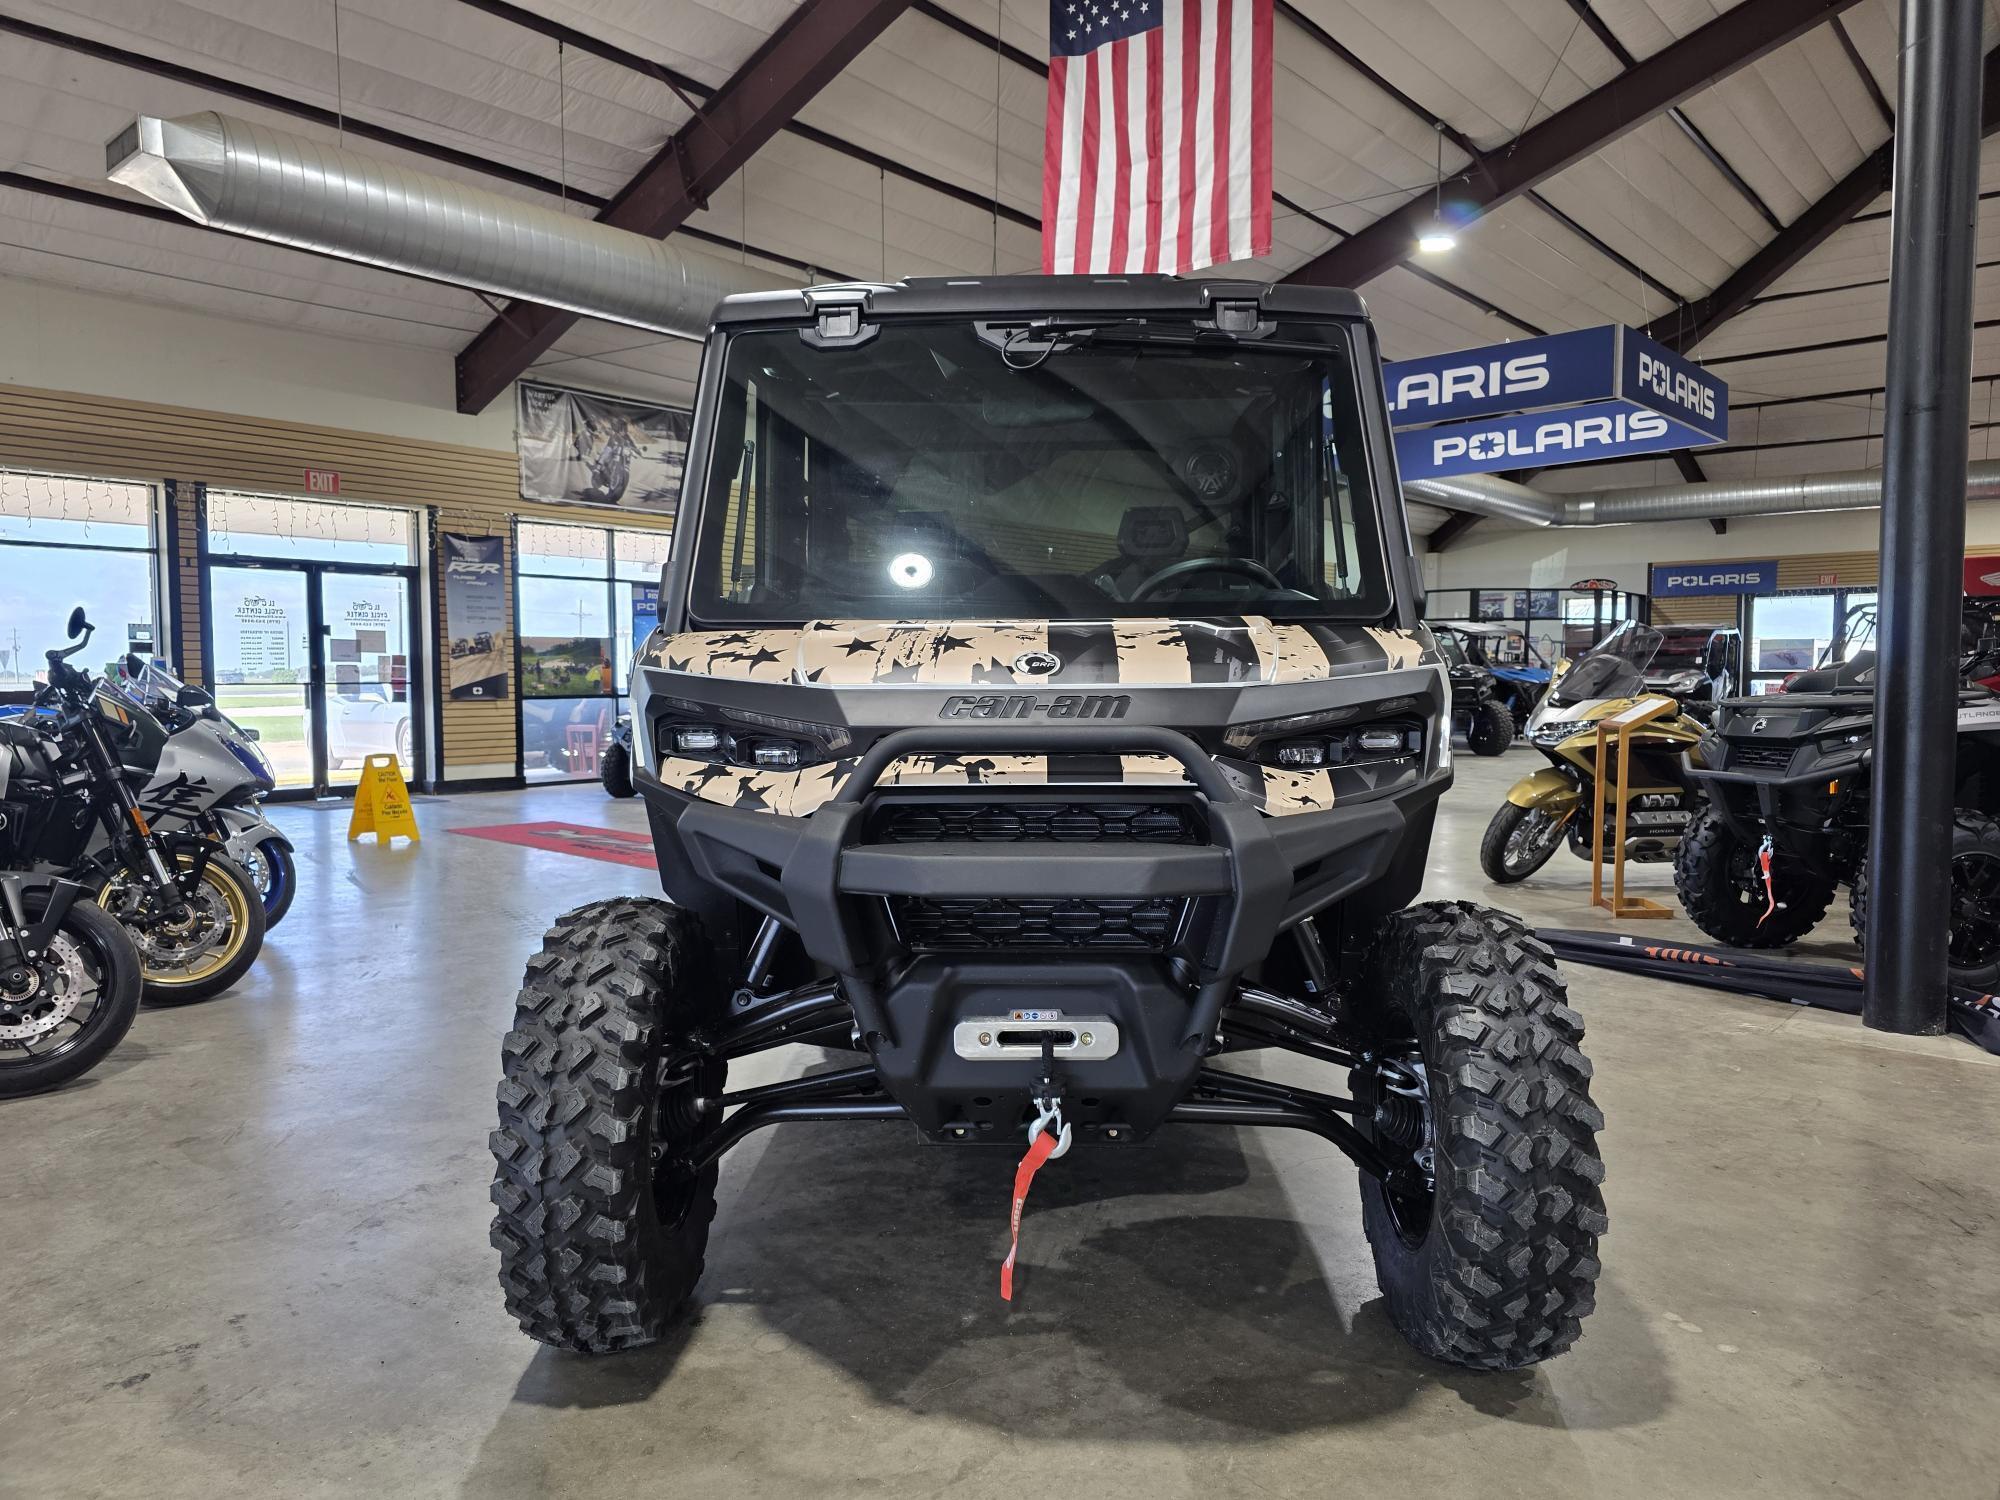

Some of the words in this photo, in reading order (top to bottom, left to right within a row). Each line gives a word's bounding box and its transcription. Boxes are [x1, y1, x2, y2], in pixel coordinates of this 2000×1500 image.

[1637, 351, 1716, 421] POLARIS
[1433, 410, 1668, 466] POLARIS
[309, 471, 335, 492] EXIT
[447, 562, 501, 574] RZR
[1667, 573, 1761, 588] POLARIS
[1820, 575, 1835, 585] EXIT
[938, 694, 1133, 719] can-am
